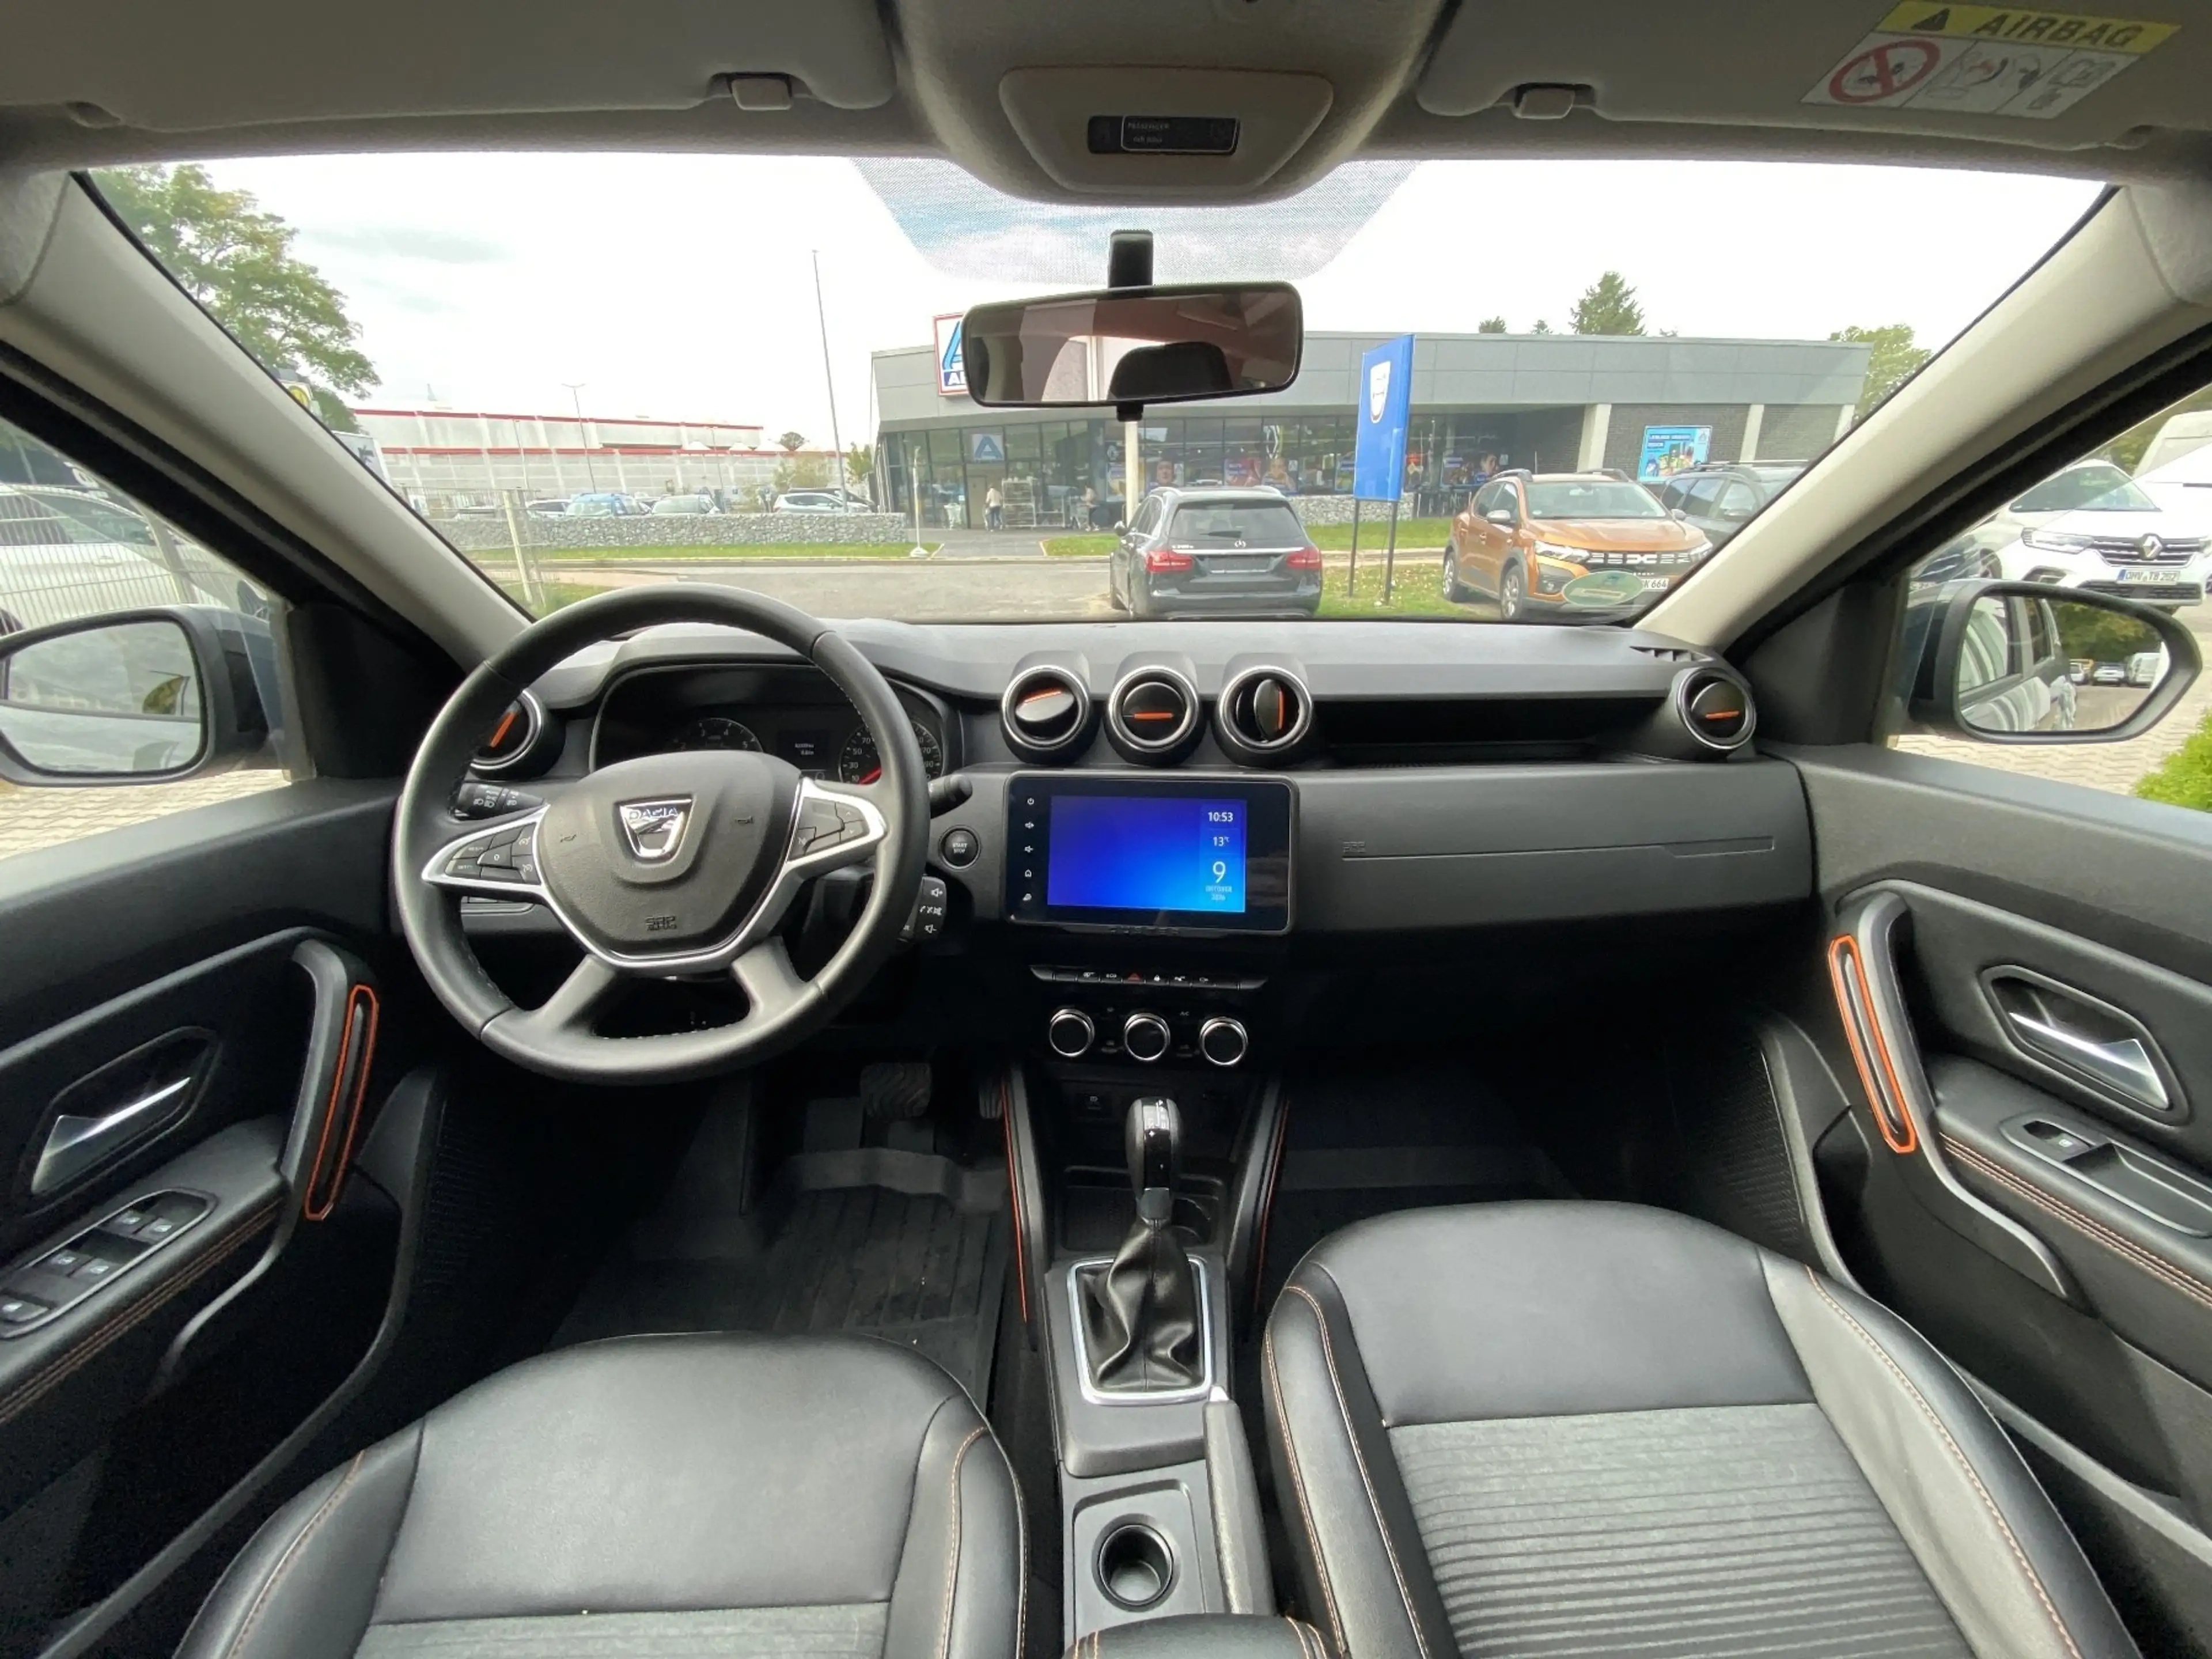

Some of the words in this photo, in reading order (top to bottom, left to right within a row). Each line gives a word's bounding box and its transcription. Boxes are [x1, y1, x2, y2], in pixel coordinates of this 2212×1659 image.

[1972, 13, 2143, 48] AIRBAG
[629, 807, 679, 819] DACIA
[1208, 812, 1233, 822] 10:53
[1213, 861, 1226, 883] 9
